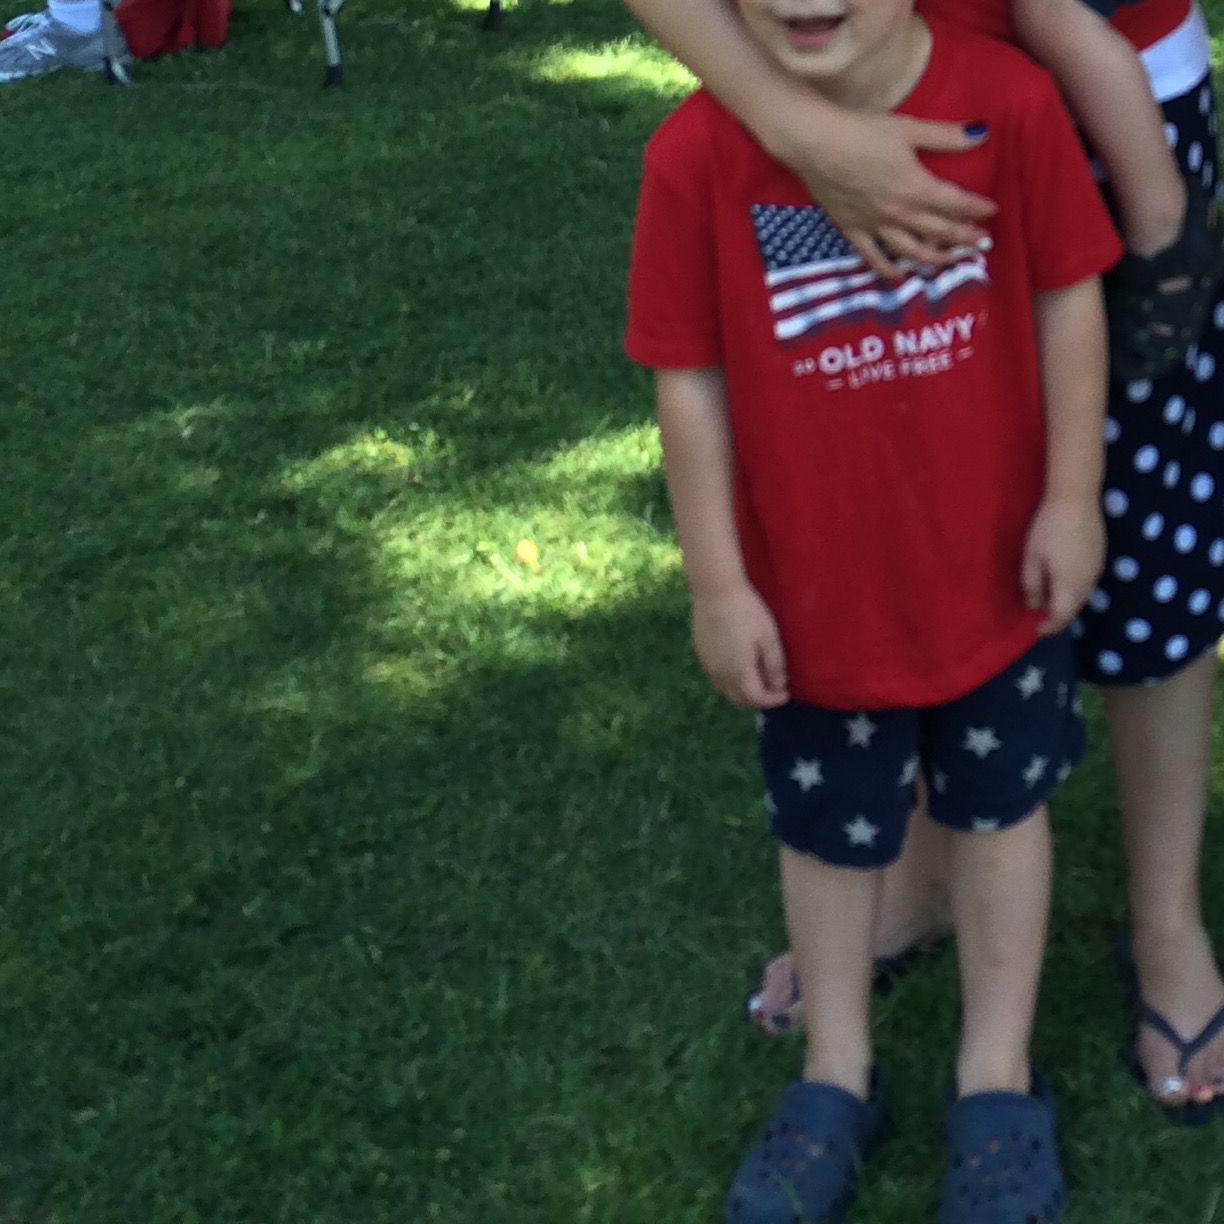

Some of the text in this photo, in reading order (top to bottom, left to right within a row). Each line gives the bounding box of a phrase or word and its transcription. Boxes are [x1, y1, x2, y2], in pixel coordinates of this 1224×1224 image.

[818, 334, 884, 375] OLD
[893, 313, 976, 357] NAVY
[849, 348, 955, 390] LIVE FREE
